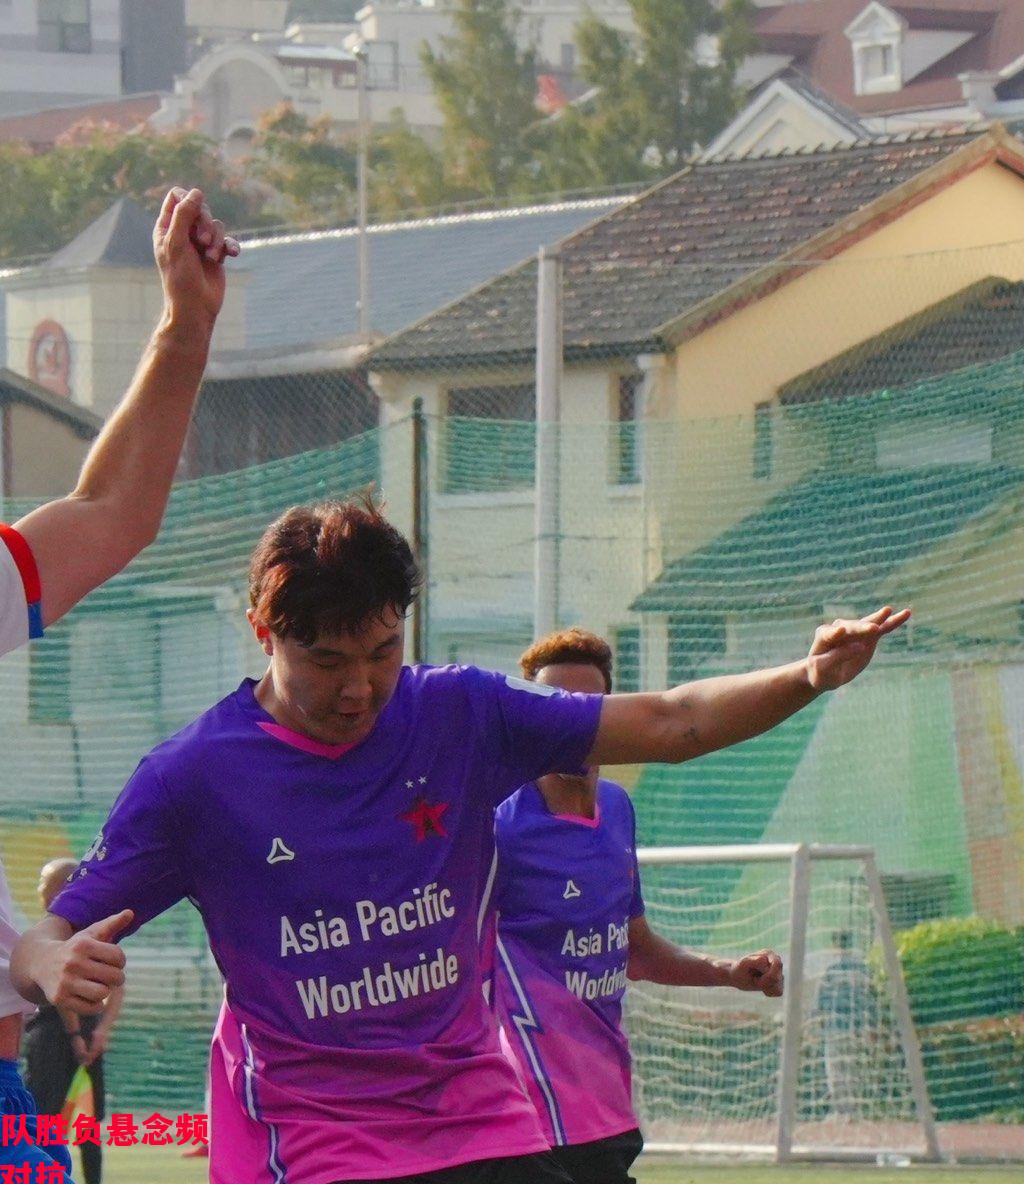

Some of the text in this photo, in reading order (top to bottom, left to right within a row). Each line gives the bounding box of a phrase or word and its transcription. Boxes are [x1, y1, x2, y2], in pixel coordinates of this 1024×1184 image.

[280, 882, 455, 957] Asia Pacific
[561, 927, 602, 957] Asia
[295, 947, 459, 1020] Worldwide
